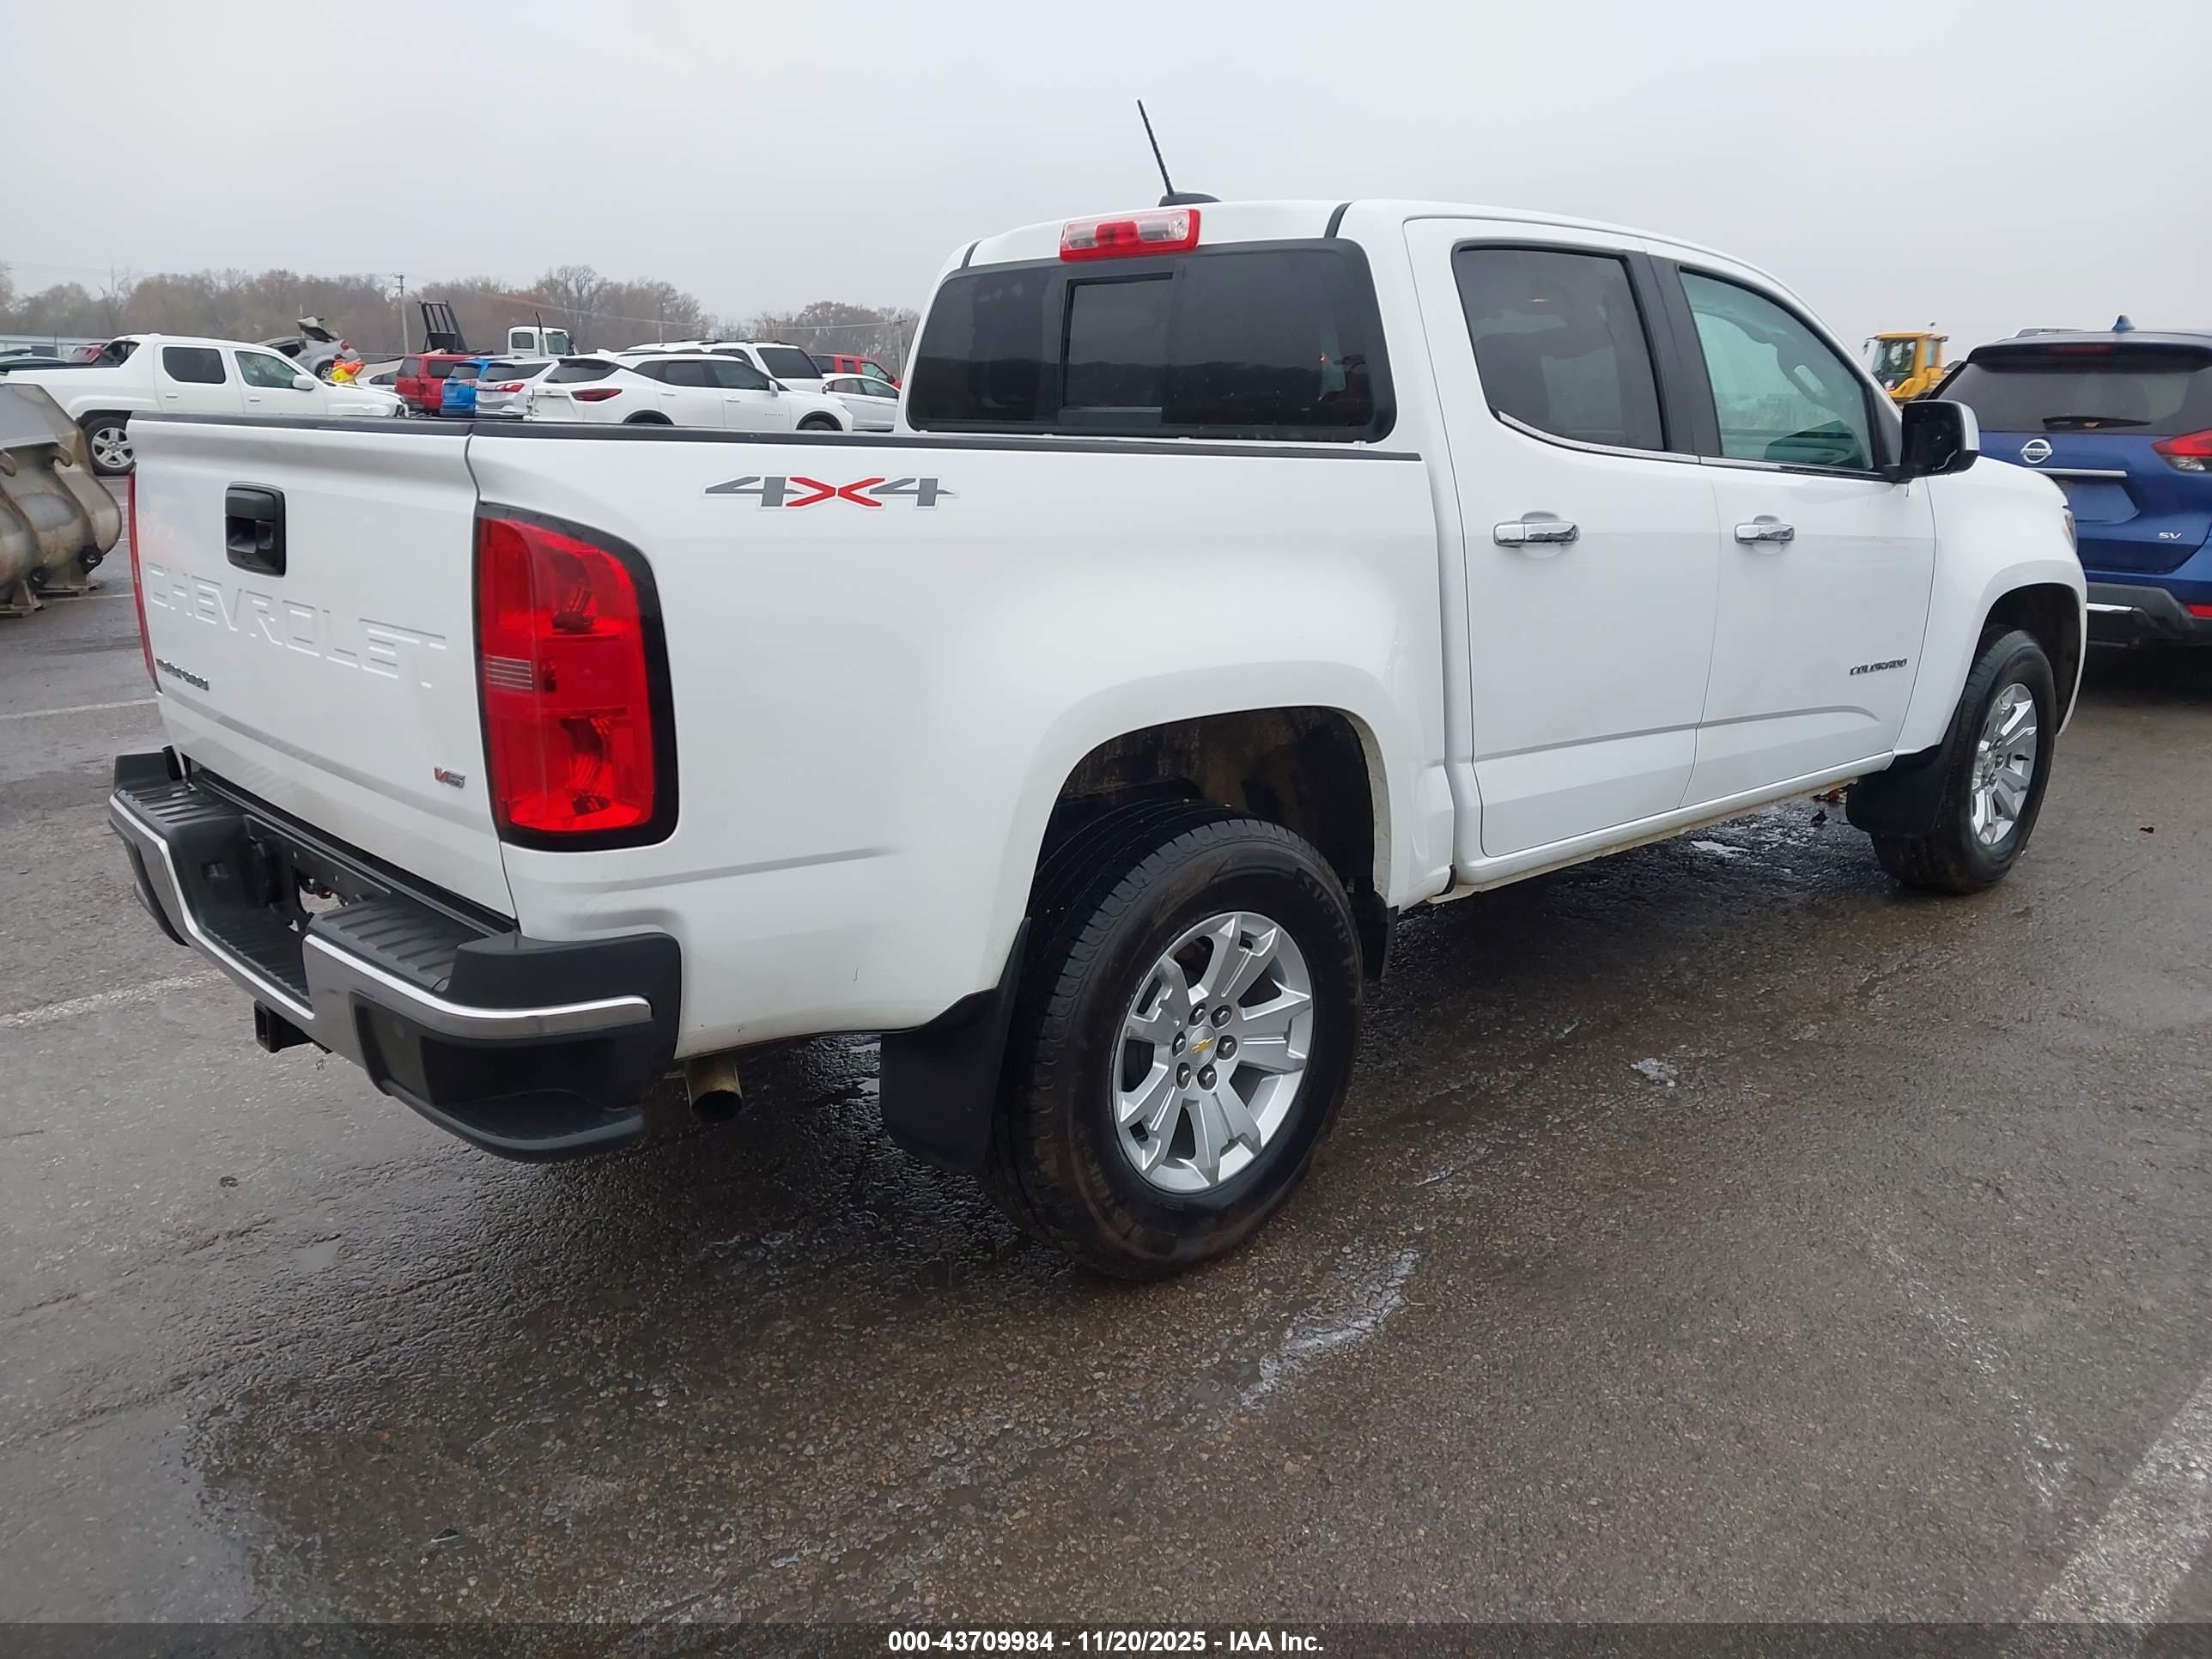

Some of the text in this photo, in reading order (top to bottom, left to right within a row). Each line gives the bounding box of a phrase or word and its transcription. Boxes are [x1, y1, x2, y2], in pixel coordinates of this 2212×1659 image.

[2158, 531, 2182, 540] SV
[148, 562, 447, 689] CHEVROLET
[433, 766, 466, 789] V6
